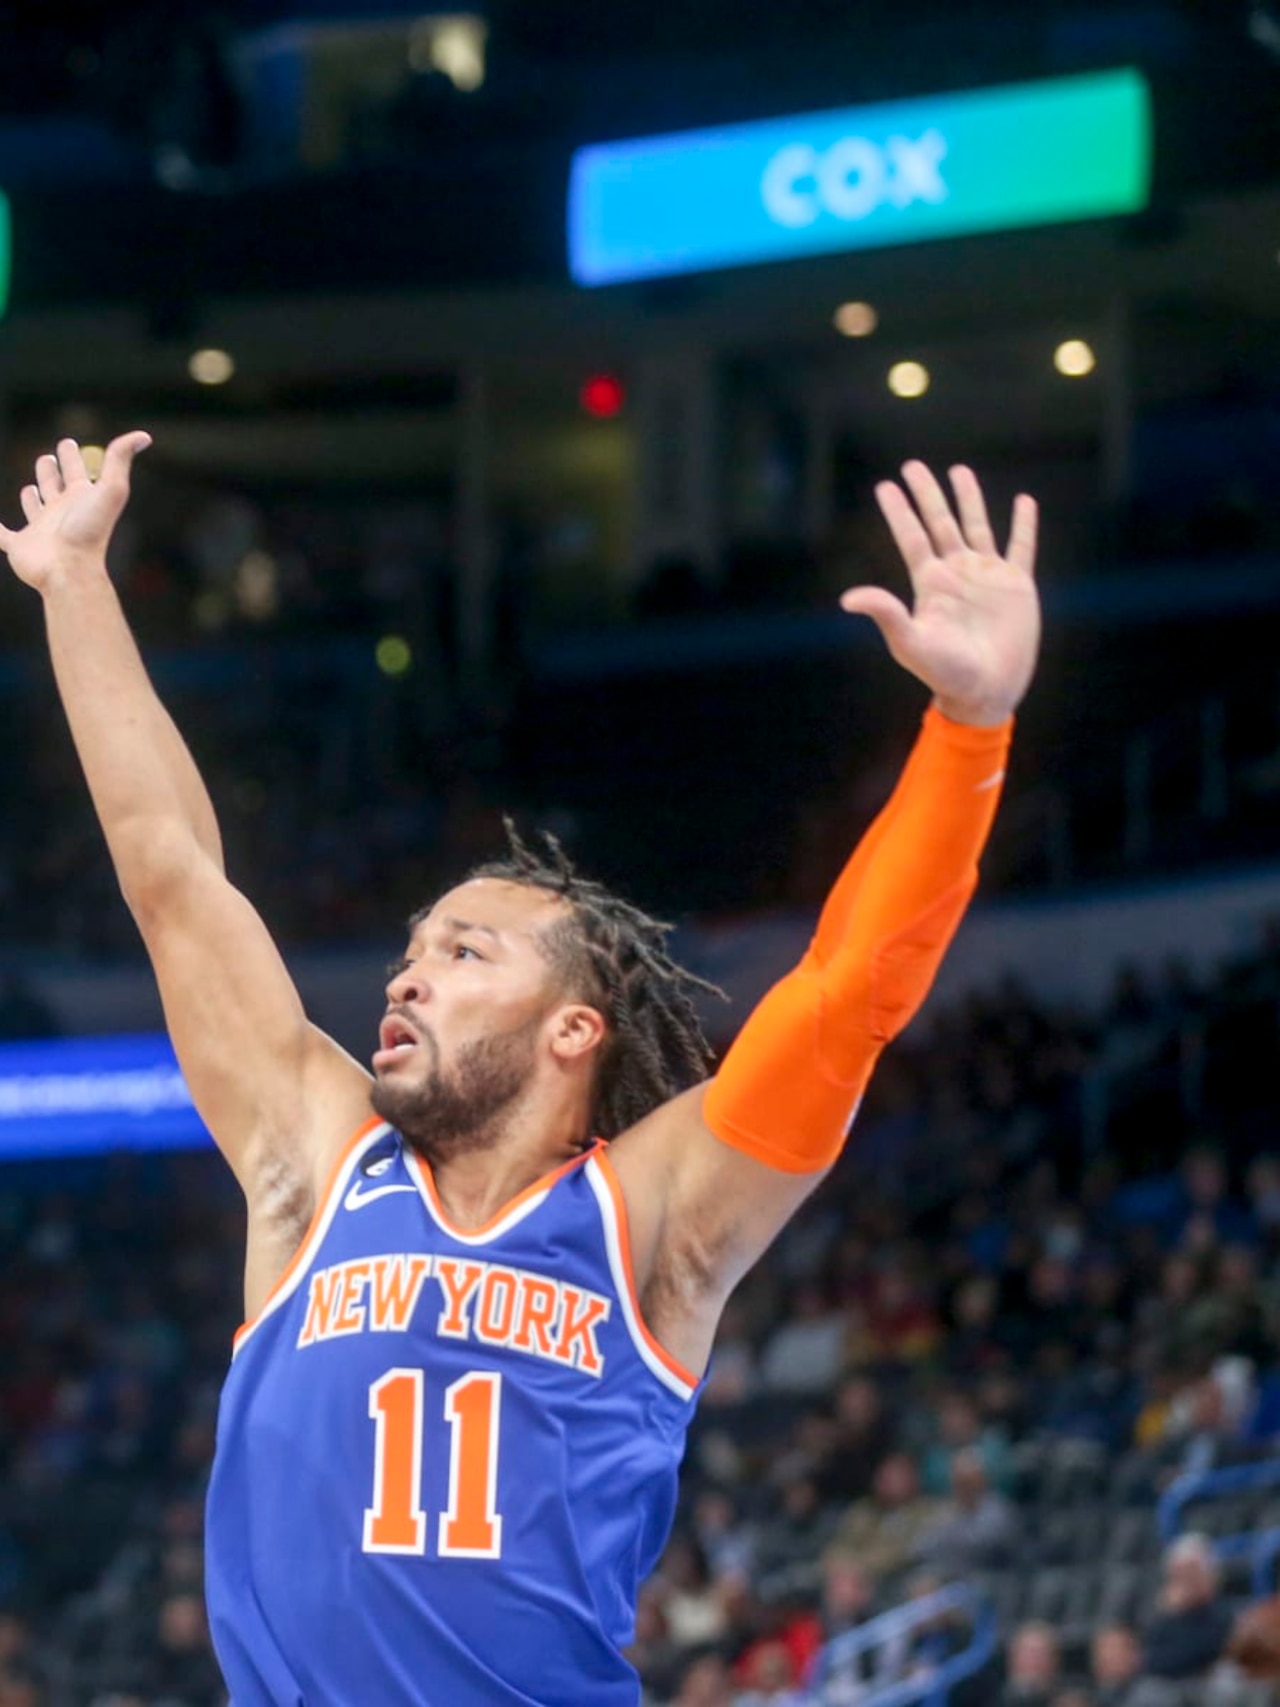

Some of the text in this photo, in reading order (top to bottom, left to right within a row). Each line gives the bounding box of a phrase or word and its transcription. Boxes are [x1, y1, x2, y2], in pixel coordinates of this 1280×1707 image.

[760, 128, 948, 228] COX
[296, 1253, 612, 1379] NEW YORK
[362, 1367, 502, 1560] 11
